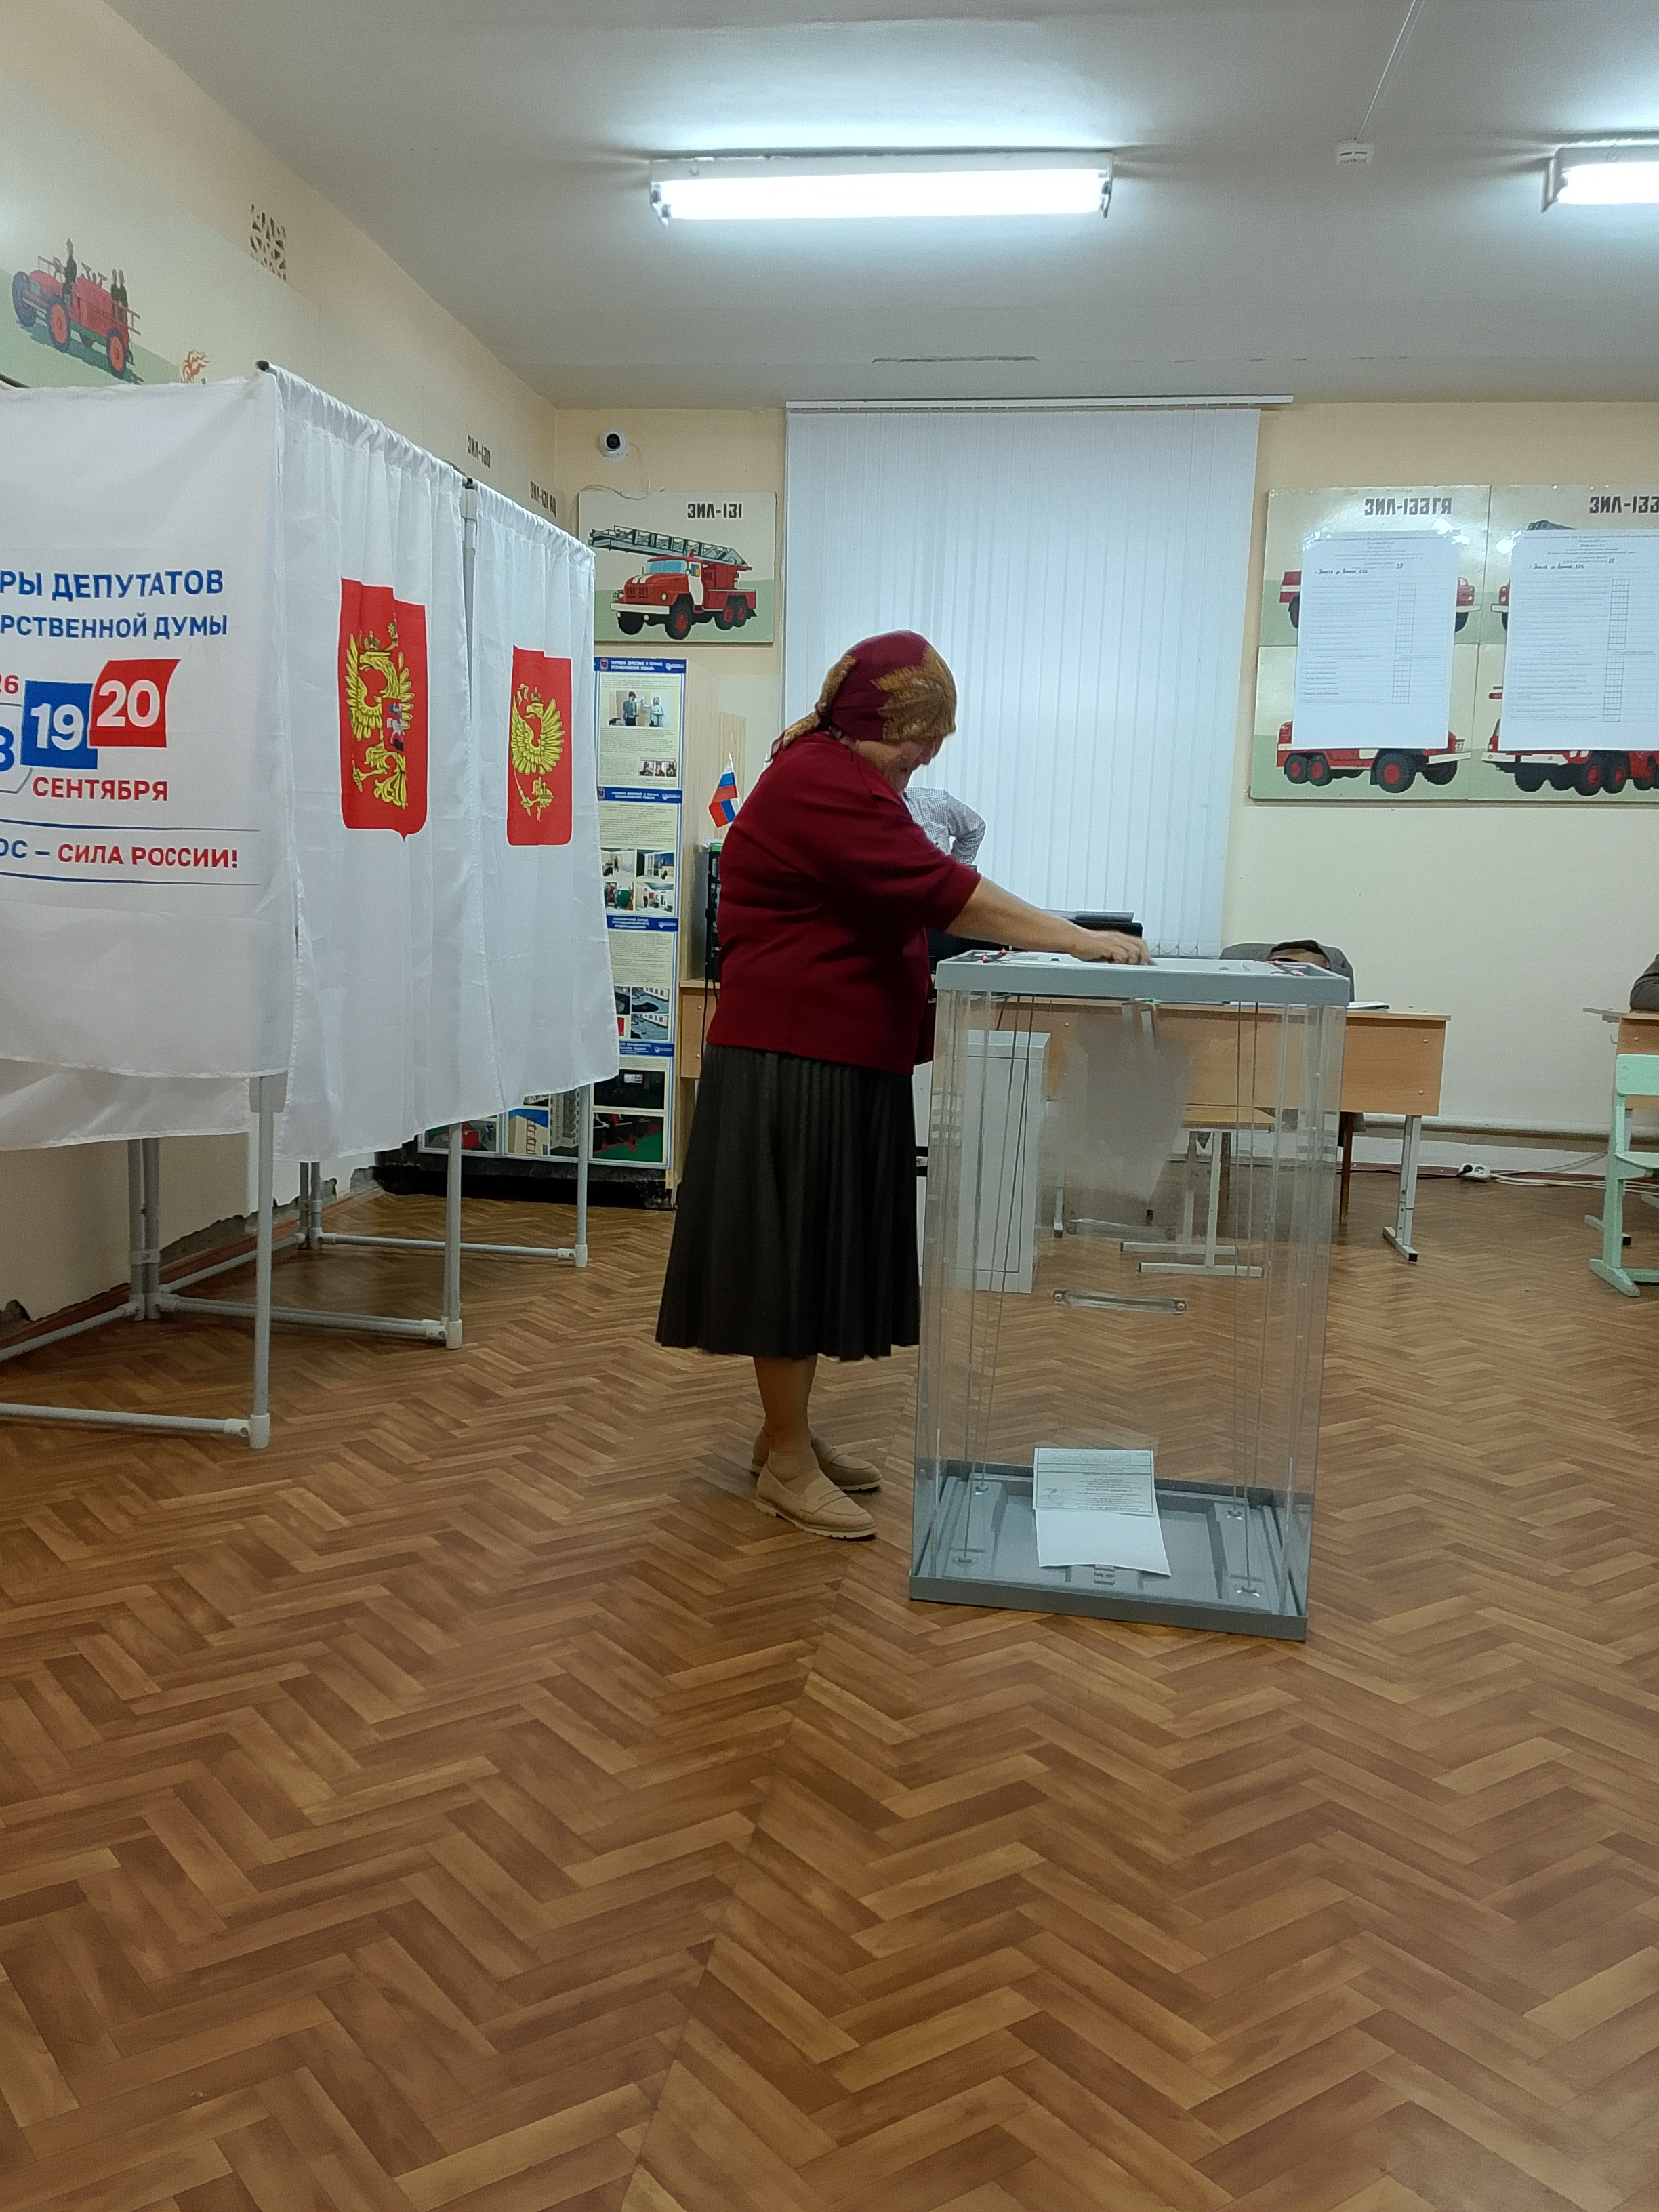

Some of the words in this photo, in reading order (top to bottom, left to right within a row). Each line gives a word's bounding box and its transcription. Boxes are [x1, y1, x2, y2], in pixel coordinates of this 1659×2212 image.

[687, 503, 742, 519] ЗИЛ-131
[1364, 497, 1452, 516] ЗИЛ-133ГЯ
[0, 571, 42, 596] РЫ
[52, 570, 223, 601] ДЕПУТАТОВ
[0, 612, 147, 638] РСТВЕННОЙ
[153, 615, 227, 640] ДУМЫ
[0, 674, 19, 694] 6
[96, 680, 160, 728] 20
[30, 703, 84, 750] 19
[33, 777, 168, 801] СЕНТЯБРЯ
[58, 844, 123, 865] СИЛА
[131, 846, 238, 869] РОССИИ!
